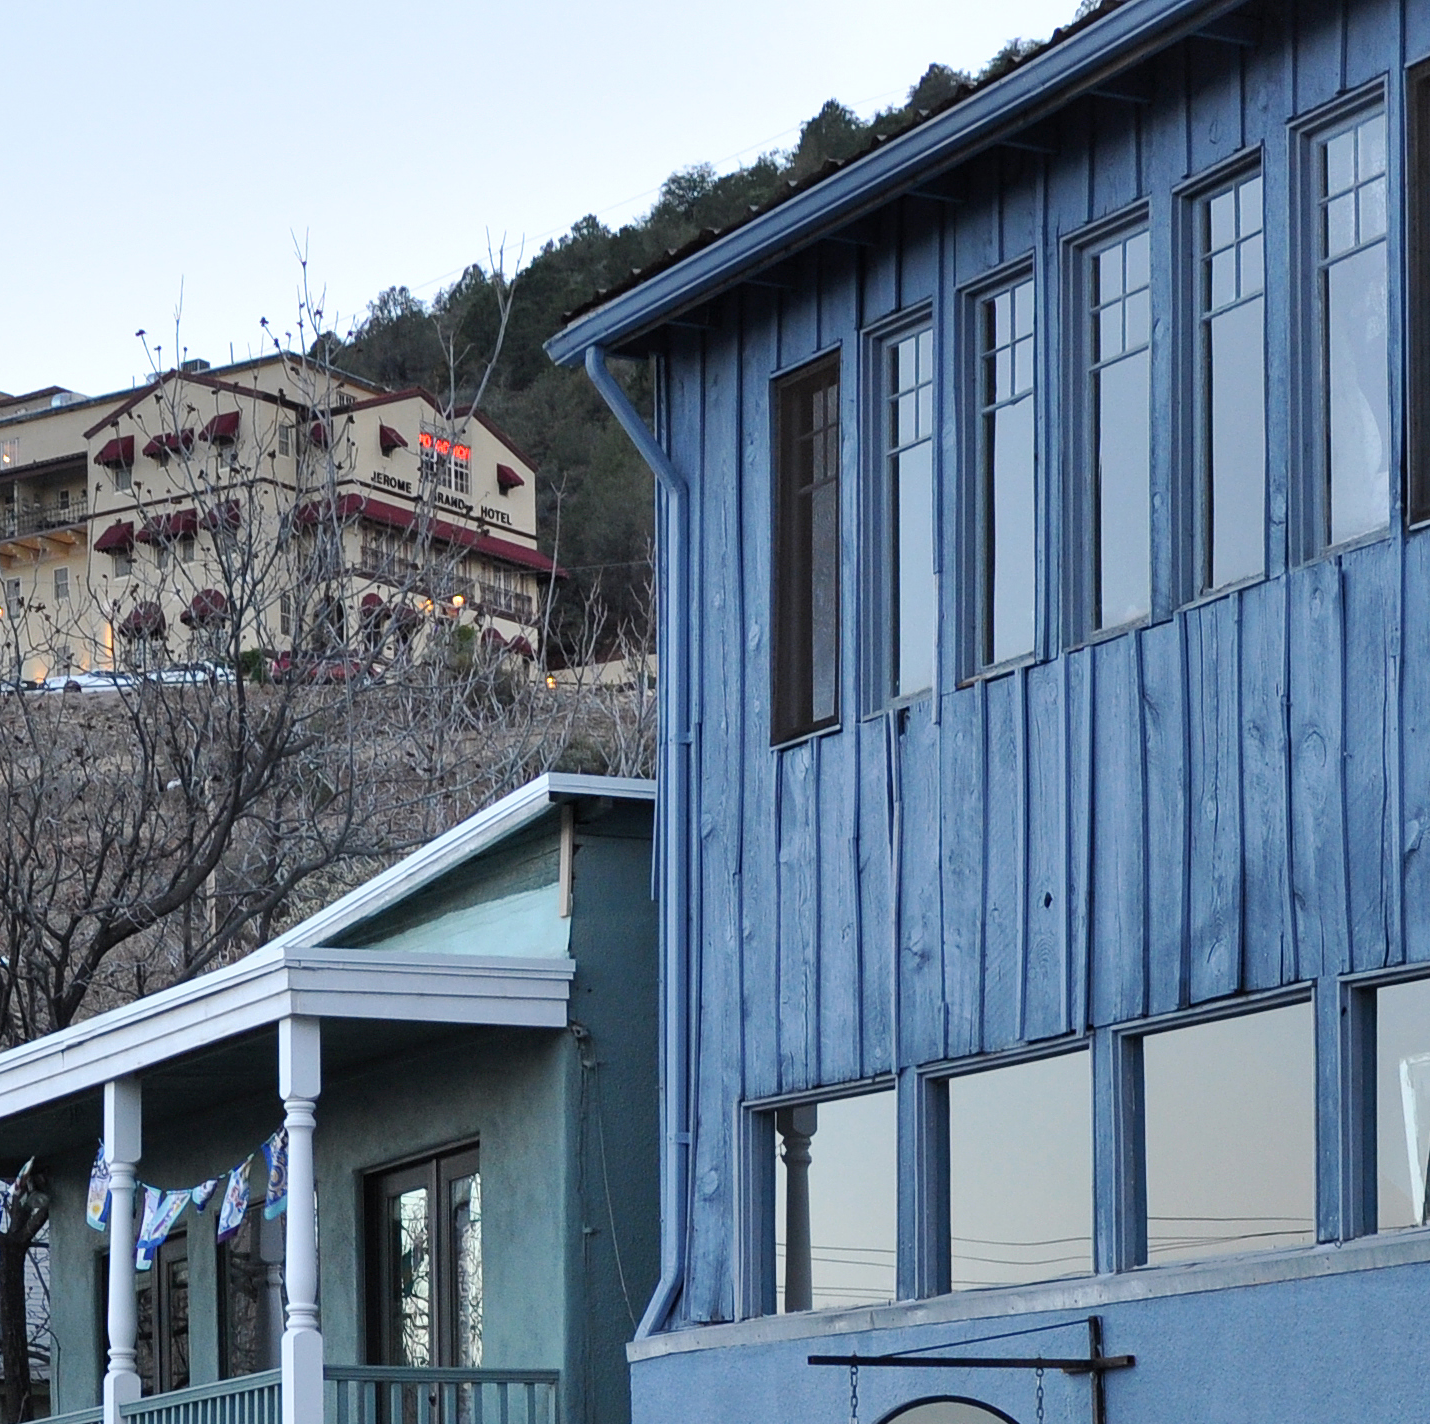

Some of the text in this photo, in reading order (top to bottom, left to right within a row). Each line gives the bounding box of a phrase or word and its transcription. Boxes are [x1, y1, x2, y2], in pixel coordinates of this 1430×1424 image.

[371, 471, 512, 526] JEROME RAND HOTEL
